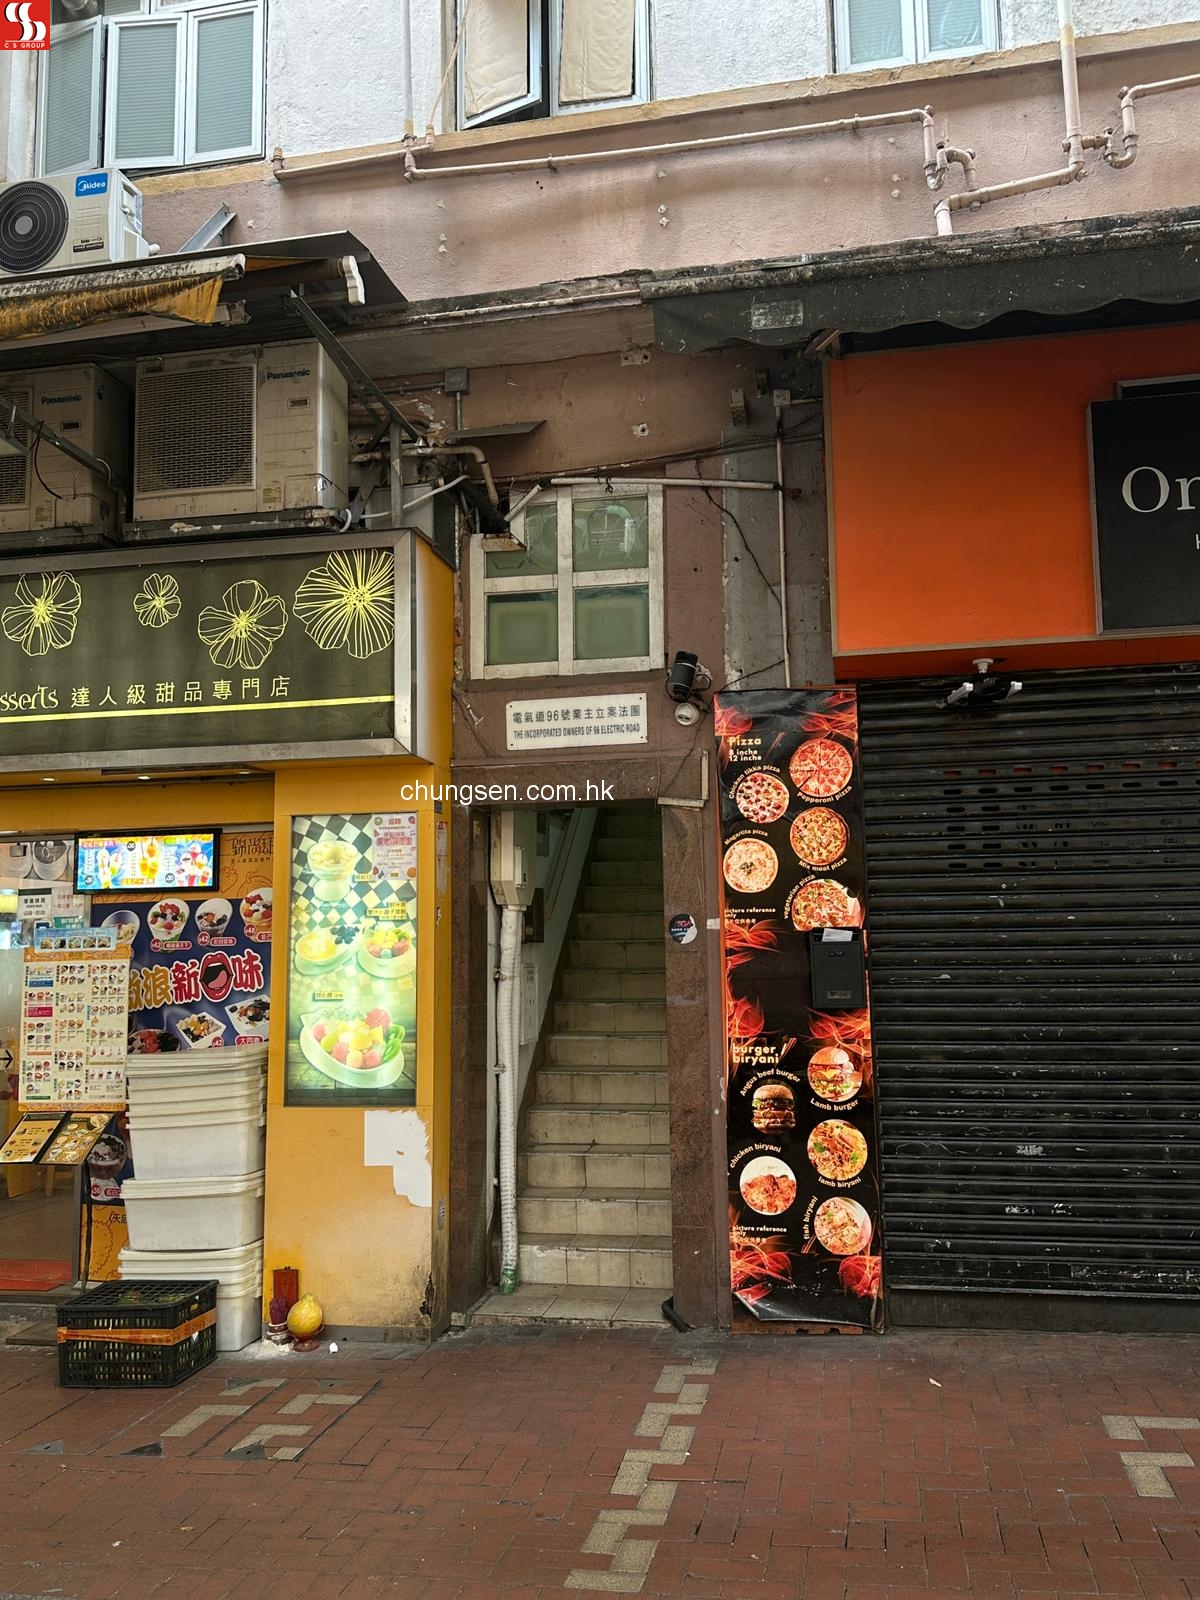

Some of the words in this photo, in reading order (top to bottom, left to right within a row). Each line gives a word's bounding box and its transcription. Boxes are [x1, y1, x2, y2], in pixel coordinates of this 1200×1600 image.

[78, 180, 106, 192] Midea
[267, 369, 311, 380] Panasonic
[41, 395, 82, 405] Panasonic
[71, 676, 290, 709] 達人級甜品專門店
[513, 730, 524, 739] THE
[524, 728, 562, 739] INCORPORATED
[563, 726, 585, 738] OWNERS
[586, 725, 593, 736] OF
[593, 725, 600, 735] 96
[600, 724, 625, 735] ELECTRIC
[625, 723, 640, 733] ROAD
[728, 736, 761, 747] Pizza
[729, 754, 738, 762] 12
[740, 754, 762, 762] inche
[736, 748, 758, 756] inche
[763, 764, 780, 773] pizza
[835, 785, 852, 801] pizza
[752, 829, 768, 837] pizza
[798, 860, 811, 870] Mix
[831, 857, 848, 870] pizza
[799, 874, 816, 886] pizza
[732, 1043, 776, 1056] burger
[732, 1053, 779, 1066] biryani
[739, 1075, 758, 1097] Angus
[757, 1068, 775, 1079] beef
[776, 1068, 801, 1083] burger
[810, 1097, 832, 1111] Lamb
[833, 1099, 859, 1111] burger
[754, 1142, 781, 1153] biryani
[837, 1176, 862, 1188] biryani
[803, 1195, 818, 1222] biryani
[756, 1225, 787, 1233] reference
[802, 1223, 810, 1240] fish
